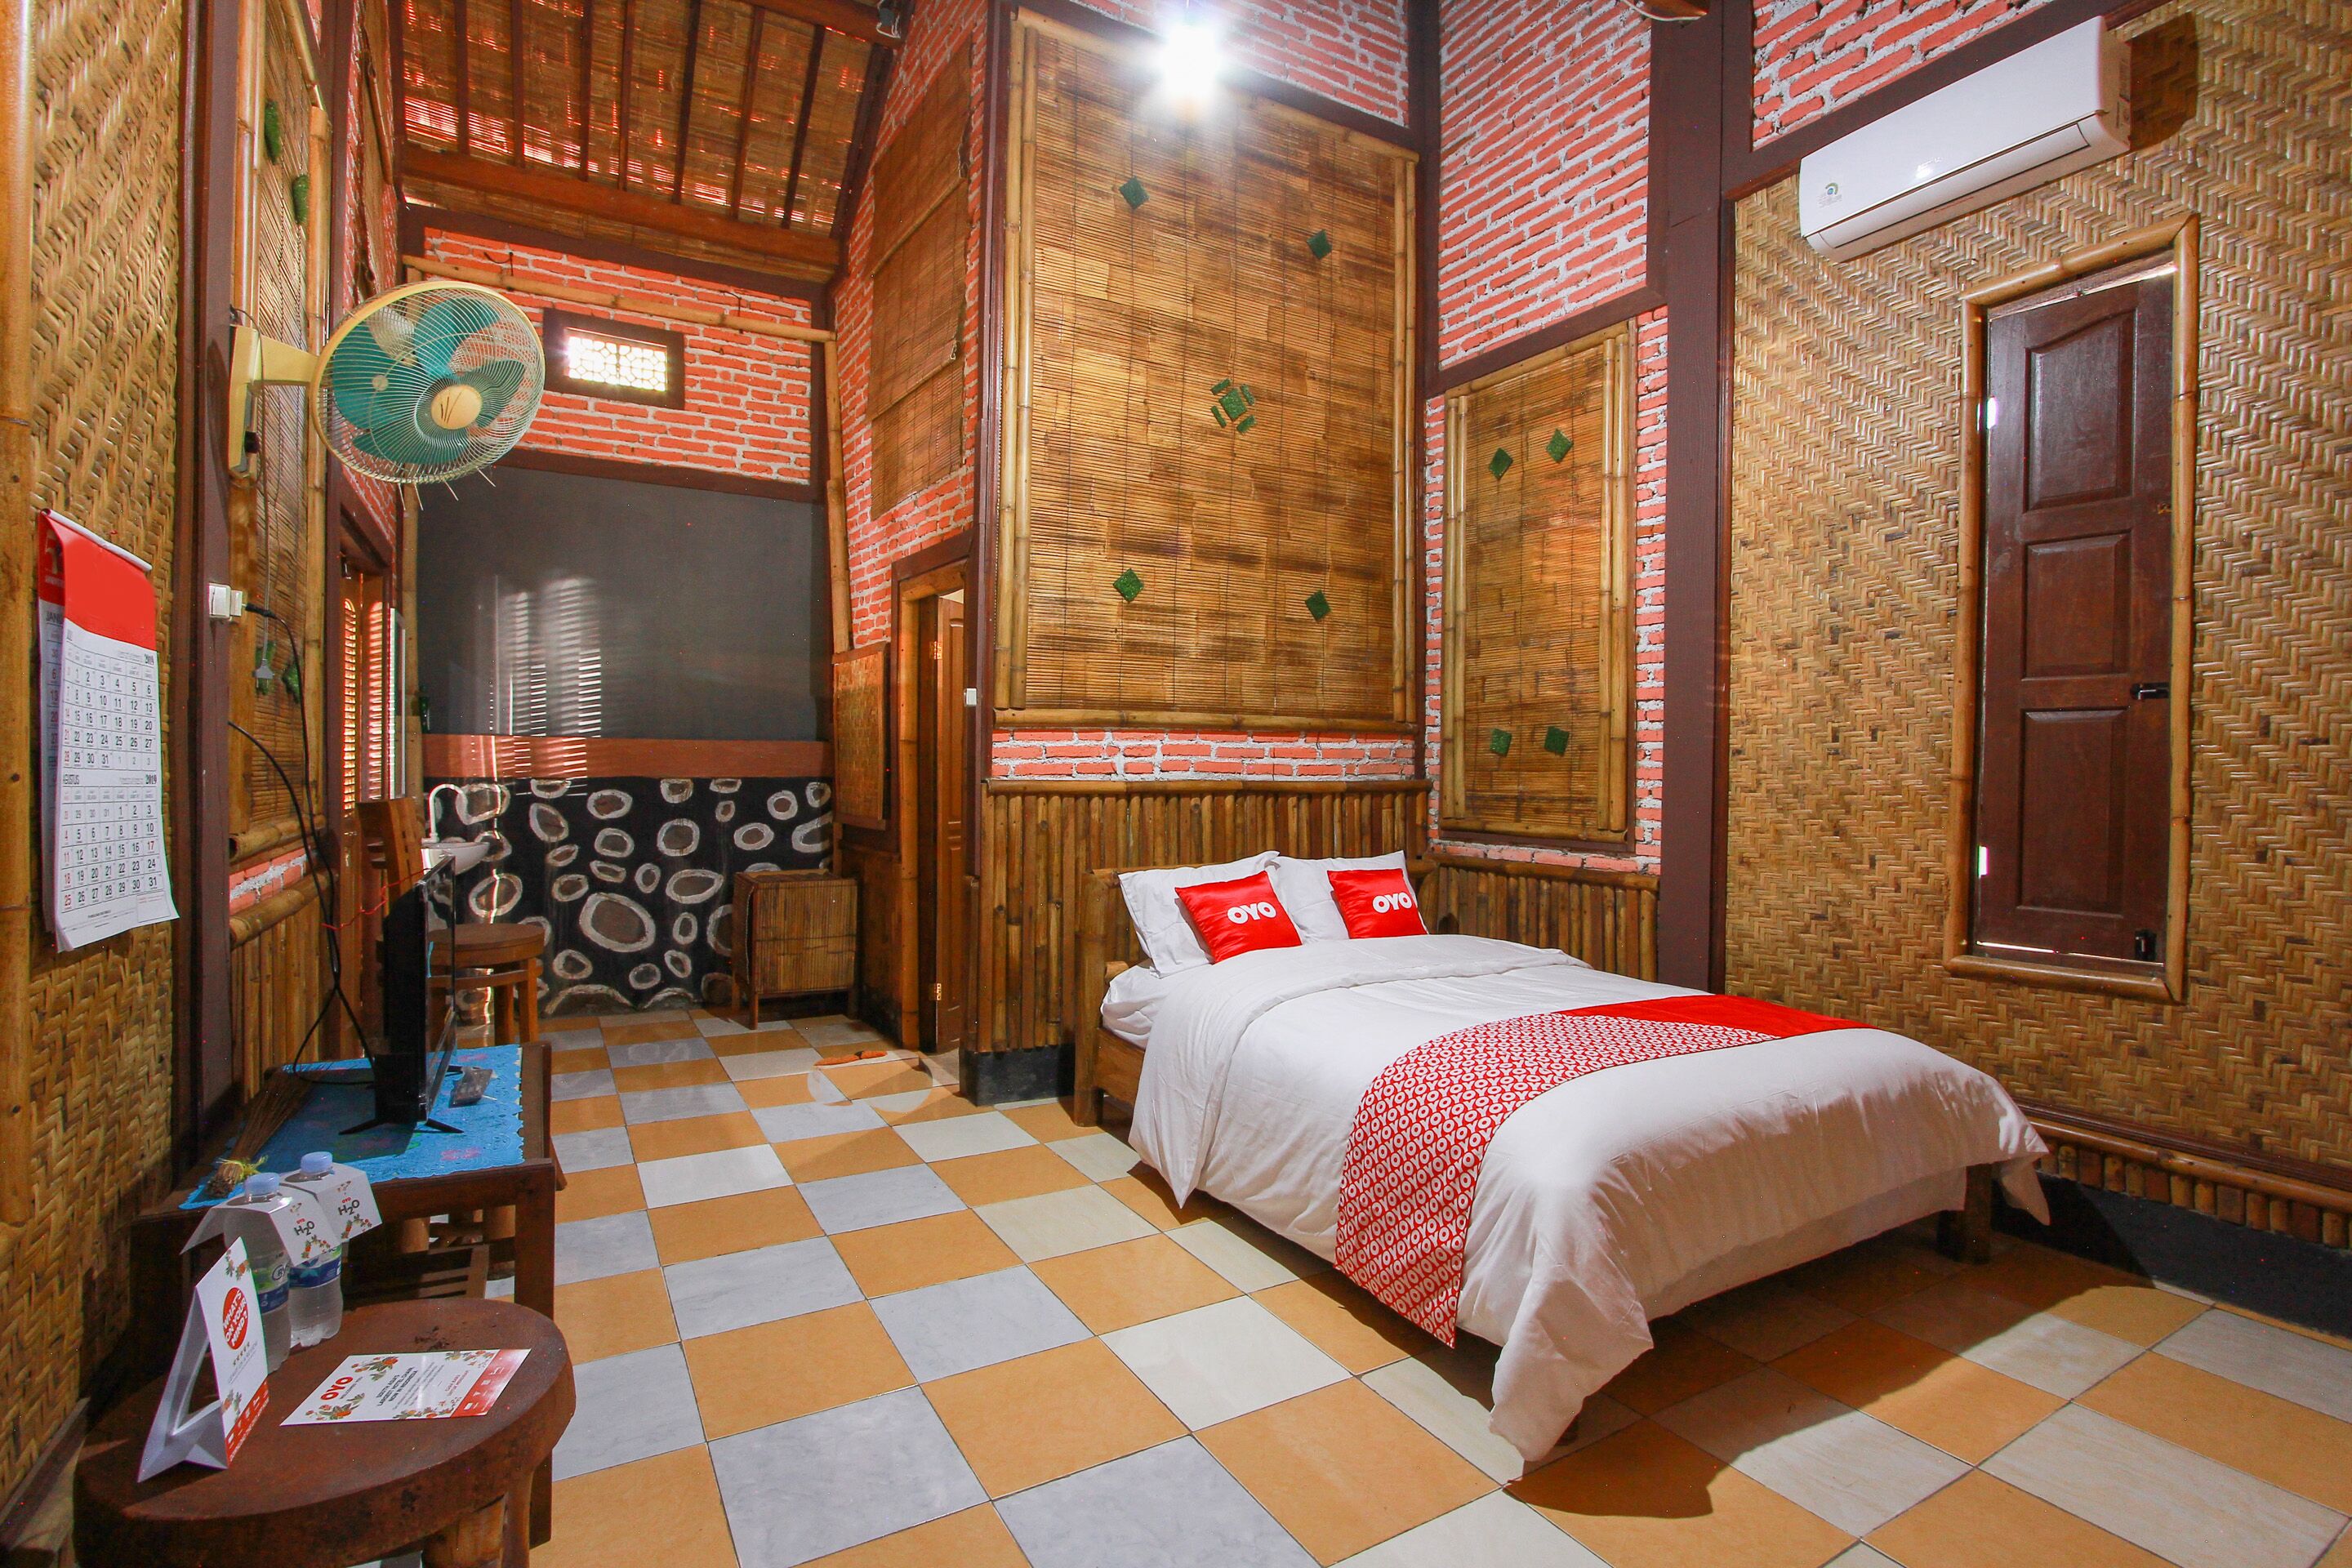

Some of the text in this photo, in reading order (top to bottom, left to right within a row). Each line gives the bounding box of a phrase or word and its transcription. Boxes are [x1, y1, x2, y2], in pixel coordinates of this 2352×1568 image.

[87, 671, 91, 683] 2
[100, 675, 105, 686] 3
[115, 679, 120, 688] 4
[132, 682, 136, 692] 5
[147, 685, 151, 695] 6
[100, 695, 108, 706] 10
[114, 698, 122, 708] 11
[131, 701, 138, 710] 12
[145, 703, 153, 713] 13
[86, 713, 92, 724] 16
[100, 715, 108, 724] 17
[114, 717, 122, 728] 18
[131, 719, 138, 729] 19
[145, 720, 153, 730] 20
[74, 731, 80, 742] 22
[87, 733, 94, 744] 23
[101, 734, 109, 745] 24
[115, 736, 123, 746] 25
[131, 737, 138, 747] 26
[145, 738, 153, 748] 27
[87, 753, 95, 764] 30
[102, 754, 109, 764] 31
[145, 774, 157, 785] 2019
[119, 806, 122, 816] 1
[133, 805, 137, 815] 2
[147, 804, 151, 815] 3
[78, 829, 81, 840] 5
[91, 827, 96, 838] 6
[105, 826, 109, 837] 7
[119, 825, 123, 835] 8
[134, 824, 137, 834] 9
[146, 822, 154, 832] 10
[76, 849, 83, 861] 12
[91, 848, 98, 858] 13
[105, 845, 112, 857] 14
[118, 844, 125, 856] 15
[131, 842, 140, 853] 16
[147, 840, 154, 851] 17
[77, 871, 84, 881] 19
[91, 868, 98, 879] 20
[105, 866, 112, 876] 21
[118, 863, 126, 874] 22
[132, 861, 140, 871] 23
[148, 858, 156, 869] 24
[65, 876, 157, 906] 25 26 27 28 29 30 31
[1372, 892, 1412, 913] OYO
[1227, 902, 1277, 924] OYO
[338, 1200, 359, 1215] H2O
[294, 1221, 314, 1236] H2O
[223, 1290, 242, 1329] WHAT'S
[225, 1297, 247, 1342] ON YOUR
[320, 1376, 354, 1401] OYO
[388, 1392, 399, 1402] NOW
